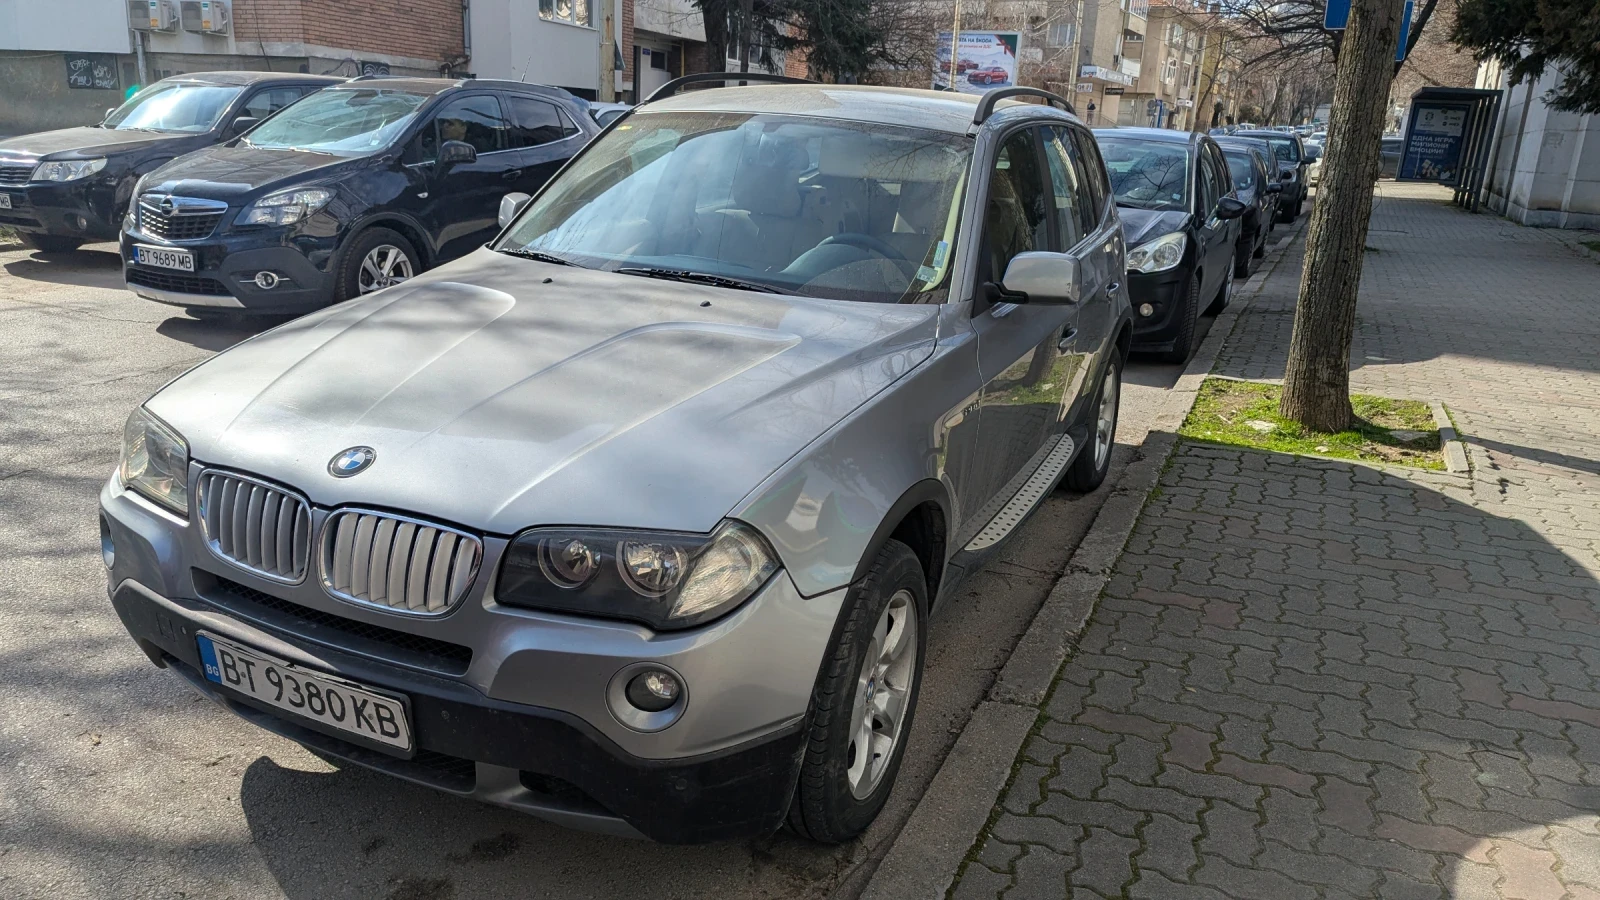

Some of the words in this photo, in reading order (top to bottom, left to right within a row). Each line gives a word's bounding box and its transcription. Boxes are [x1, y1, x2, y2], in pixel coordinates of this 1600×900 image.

[1411, 141, 1449, 149] МИЛИОНИ
[139, 249, 150, 263] BT
[153, 251, 176, 267] 9689
[178, 254, 192, 269] MB
[205, 664, 219, 677] BG
[219, 648, 255, 692] BT
[265, 666, 346, 722] 9380
[350, 694, 400, 739] KB
